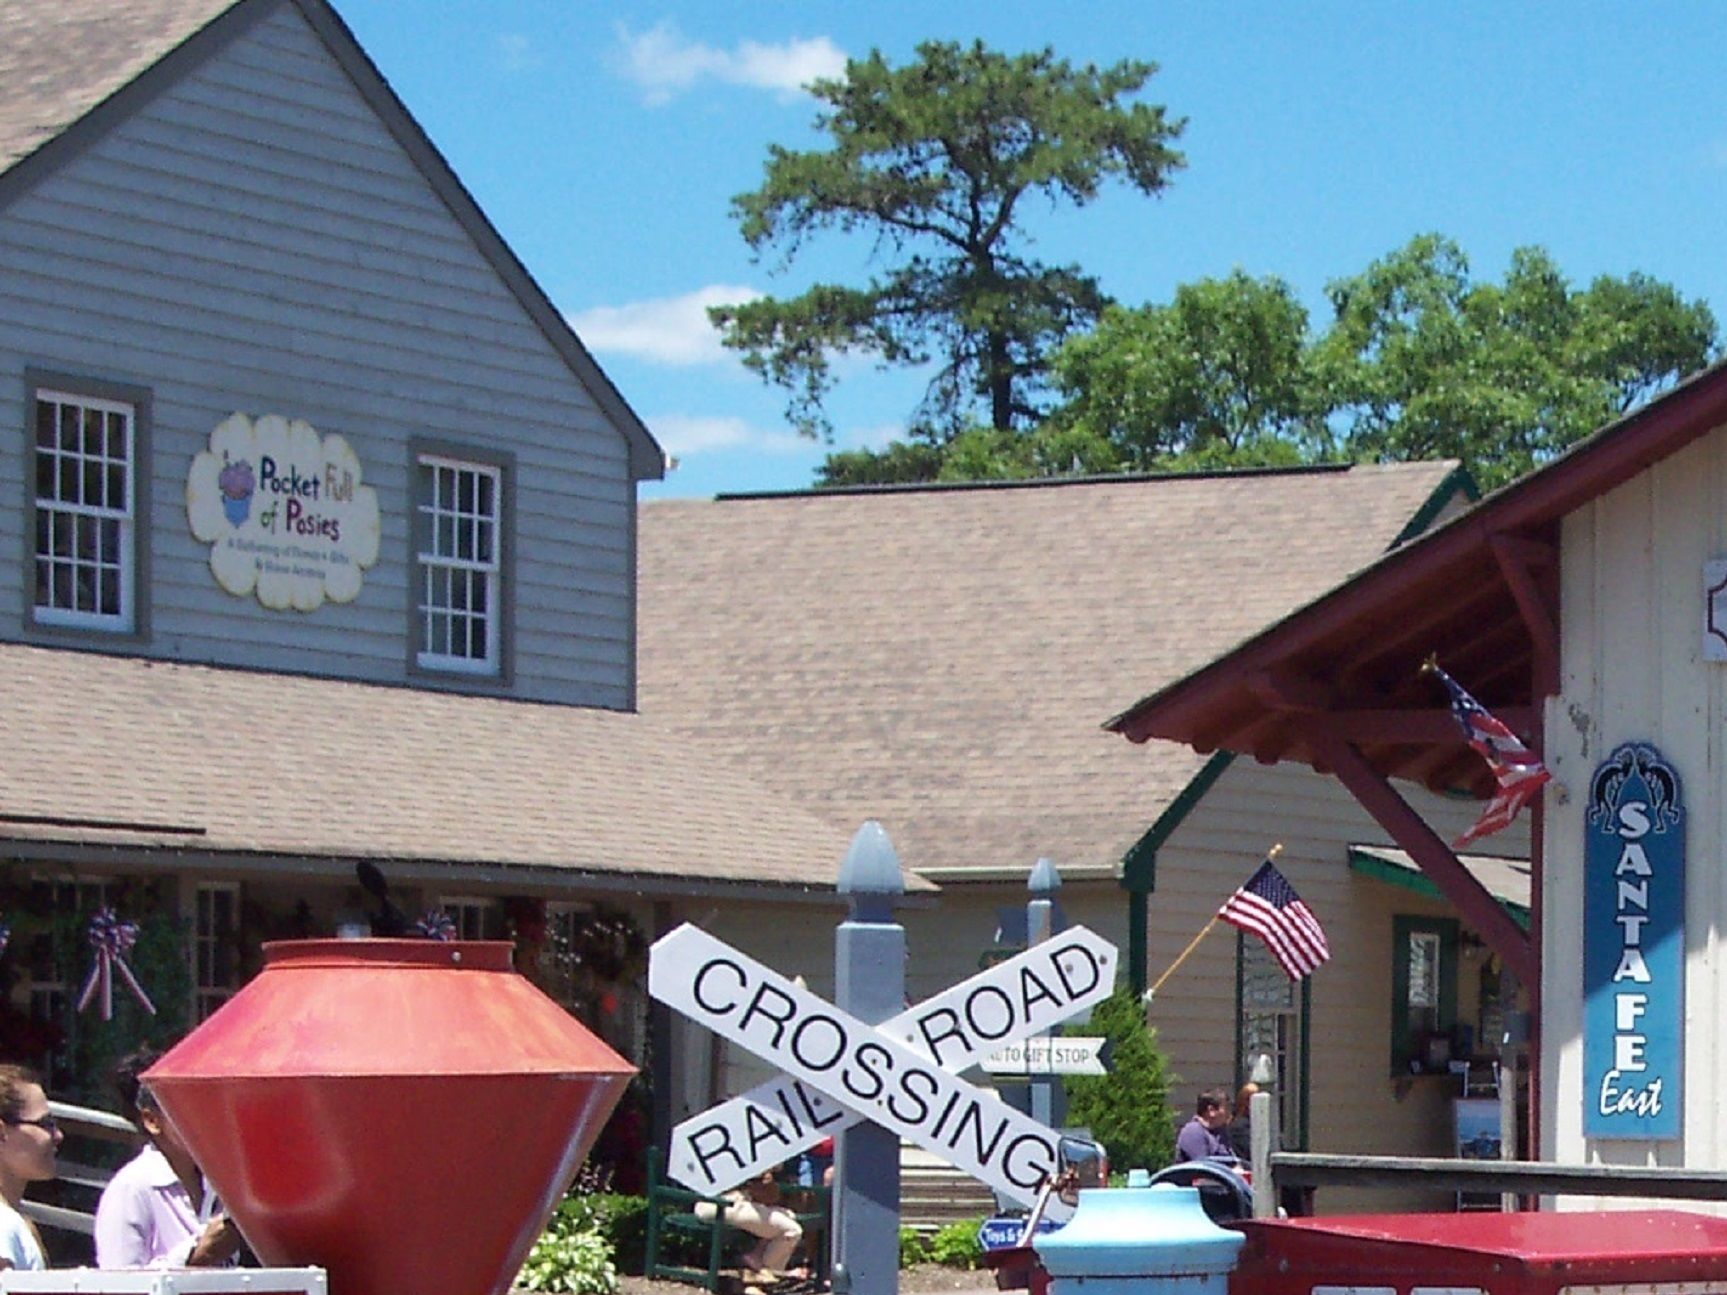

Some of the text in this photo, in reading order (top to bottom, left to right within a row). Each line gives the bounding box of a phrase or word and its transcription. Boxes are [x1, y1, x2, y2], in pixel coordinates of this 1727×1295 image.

[260, 455, 354, 502] Pocket Full
[260, 498, 340, 542] of Posies
[1613, 802, 1652, 1071] SANTA FE
[687, 943, 1100, 1184] RAIL ROAD
[692, 957, 1056, 1195] CROSSING
[1055, 1047, 1090, 1064] STOP
[1600, 1069, 1662, 1117] East
